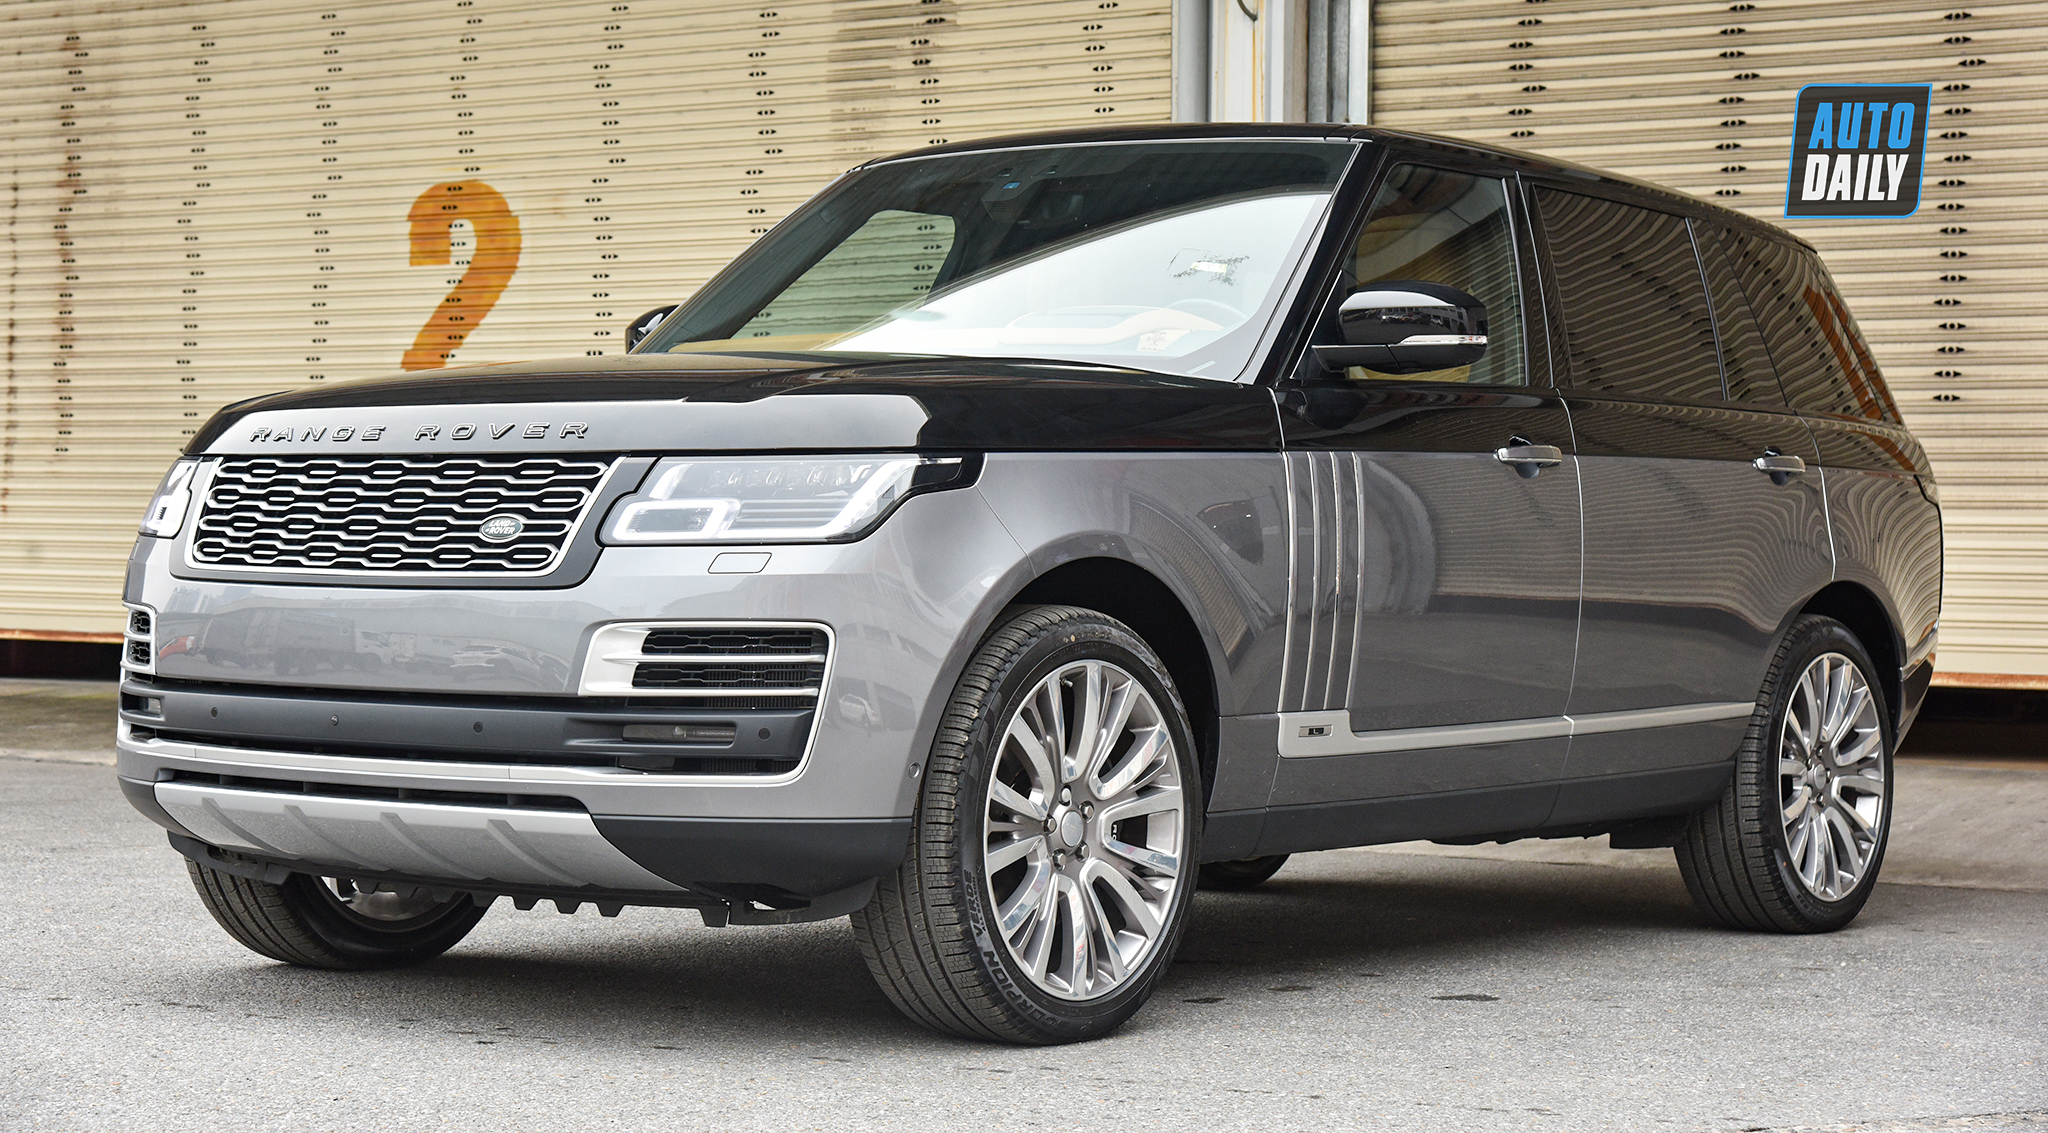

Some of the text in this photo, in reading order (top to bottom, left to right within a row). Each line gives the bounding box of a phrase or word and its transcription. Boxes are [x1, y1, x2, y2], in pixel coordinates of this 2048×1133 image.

[401, 179, 522, 372] 2
[249, 421, 588, 442] RANGE ROVER
[488, 526, 516, 535] ROVER
[489, 519, 512, 527] LAND
[963, 869, 983, 938] VERDE
